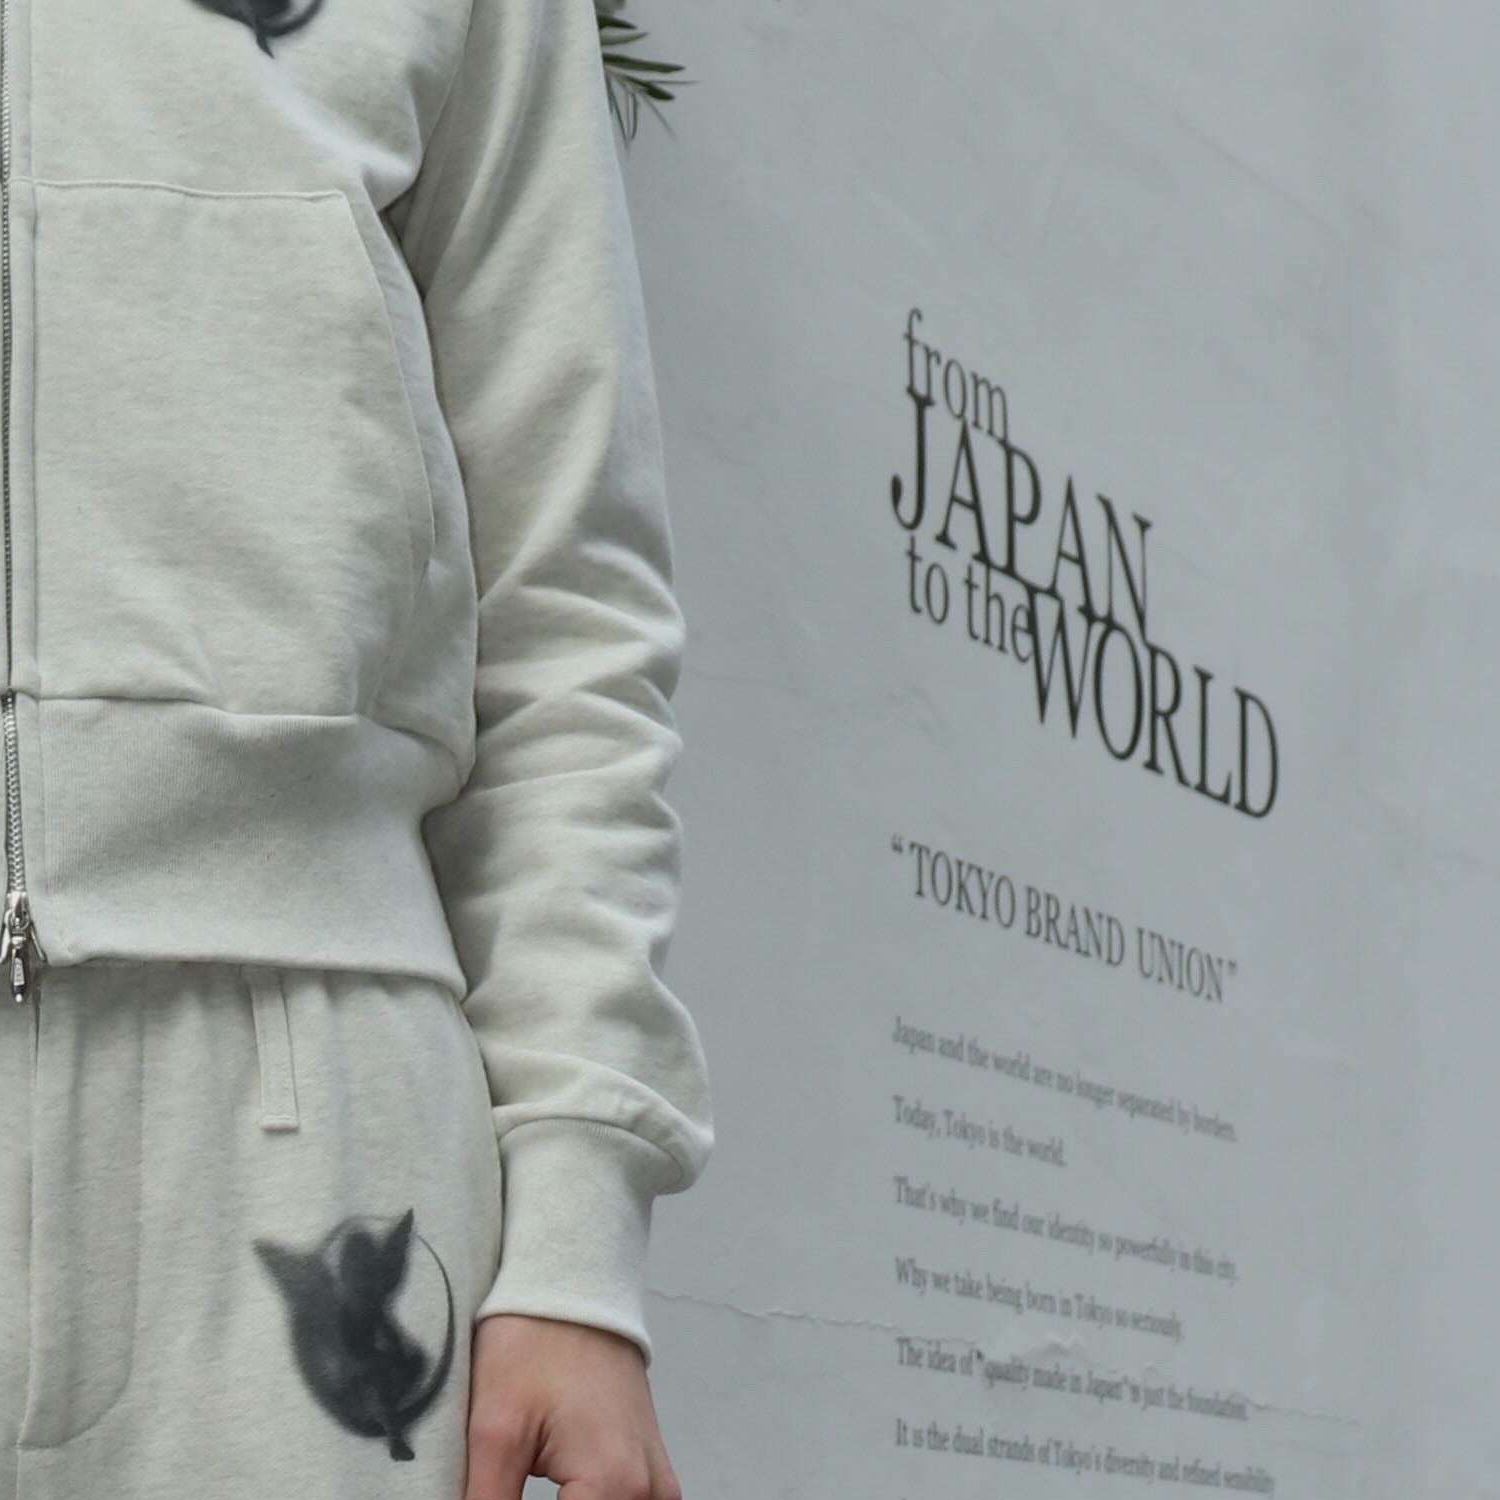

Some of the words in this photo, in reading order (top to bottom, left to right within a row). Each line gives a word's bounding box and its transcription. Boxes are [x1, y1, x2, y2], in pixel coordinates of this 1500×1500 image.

[904, 308, 1008, 442] from
[891, 393, 1152, 639] JAPAN
[906, 536, 949, 625] to
[964, 556, 1034, 663] the
[1028, 586, 1278, 819] WORLD
[1025, 885, 1124, 967] BRAND
[943, 1109, 986, 1149] Tokyo
[1002, 1126, 1023, 1156] the
[1026, 1137, 1067, 1167] world.
